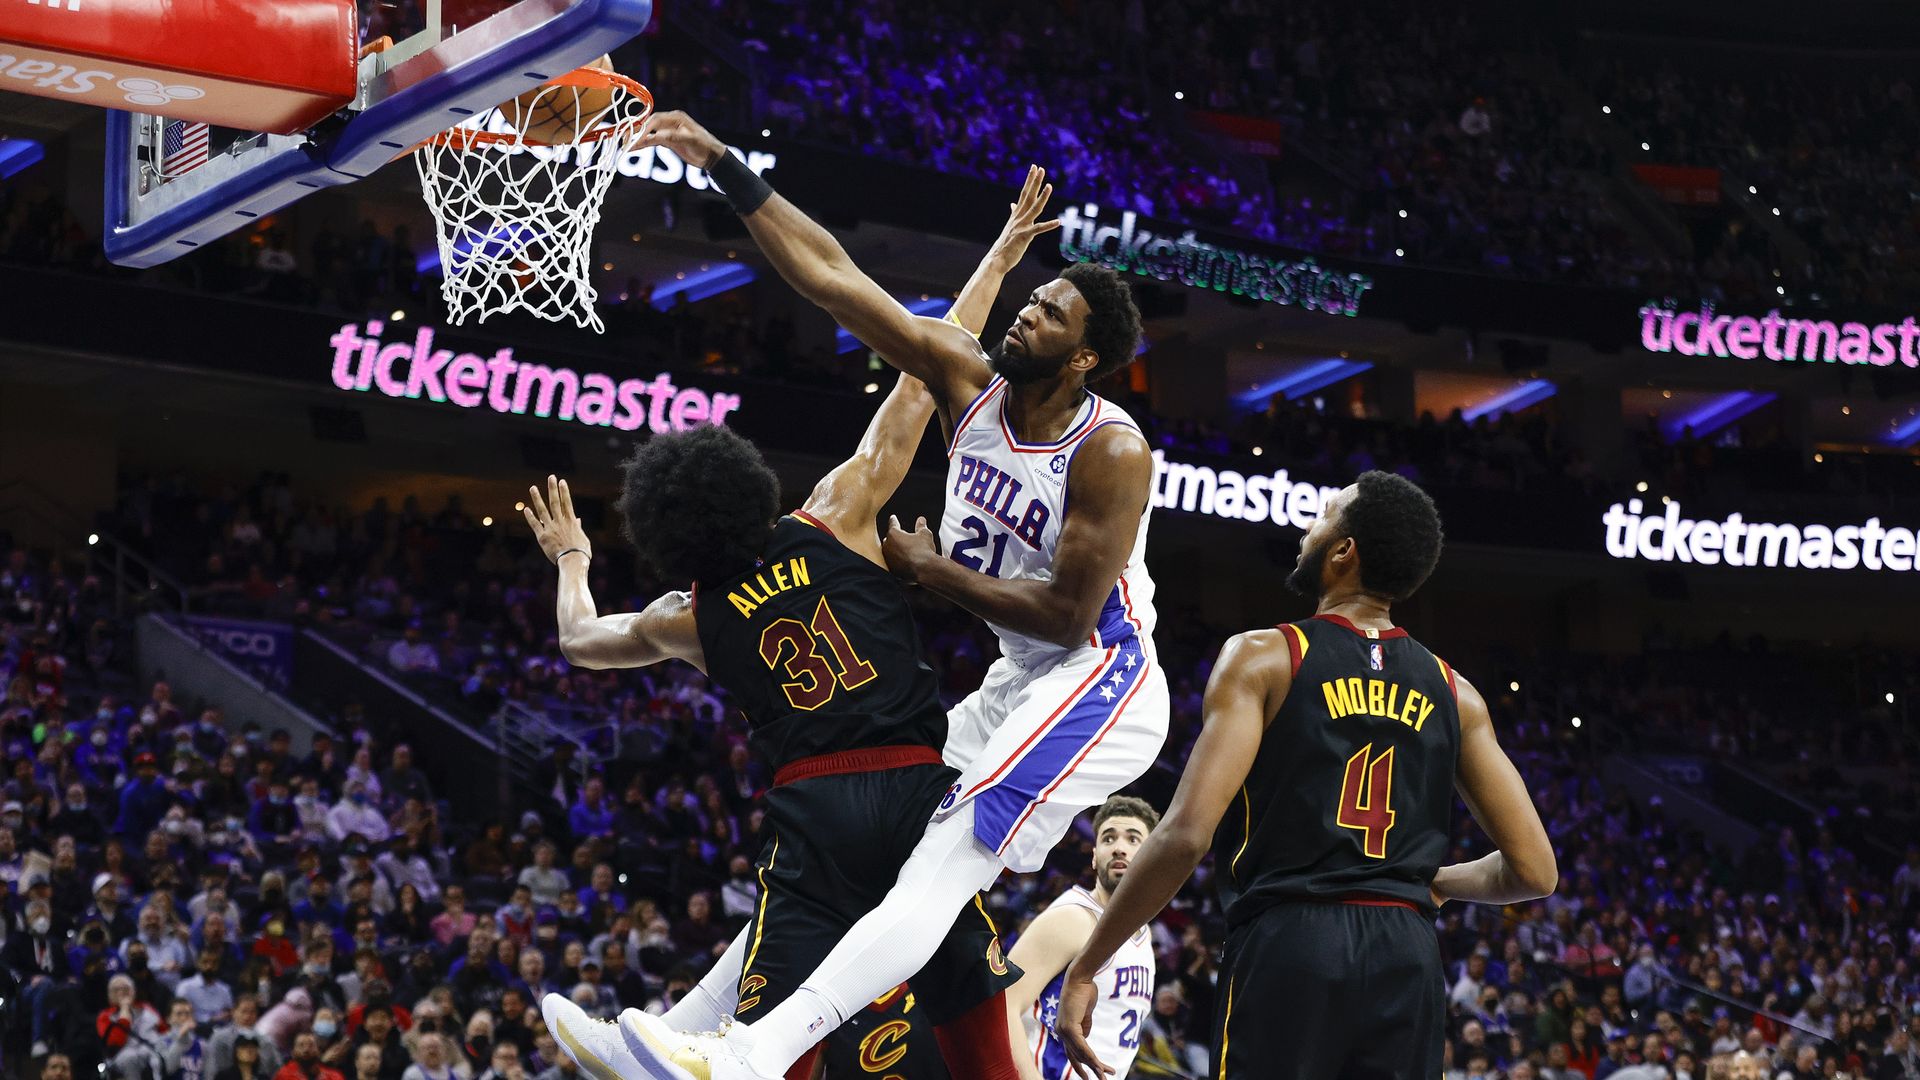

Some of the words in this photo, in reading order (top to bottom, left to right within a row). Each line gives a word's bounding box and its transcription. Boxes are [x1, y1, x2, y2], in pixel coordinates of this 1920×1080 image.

[0, 55, 115, 93] Sta
[1639, 297, 1920, 368] ticketmast
[330, 319, 741, 434] ticketmaster
[953, 455, 1050, 551] PHILA
[1034, 468, 1062, 487] crypto.co
[950, 515, 1009, 578] 21
[1602, 498, 1920, 571] ticketmaste
[727, 556, 811, 619] ALLEN
[759, 594, 878, 711] 31
[1322, 677, 1434, 732] MOBLEY
[1337, 742, 1396, 859] 4
[1108, 965, 1152, 1000] PHIL
